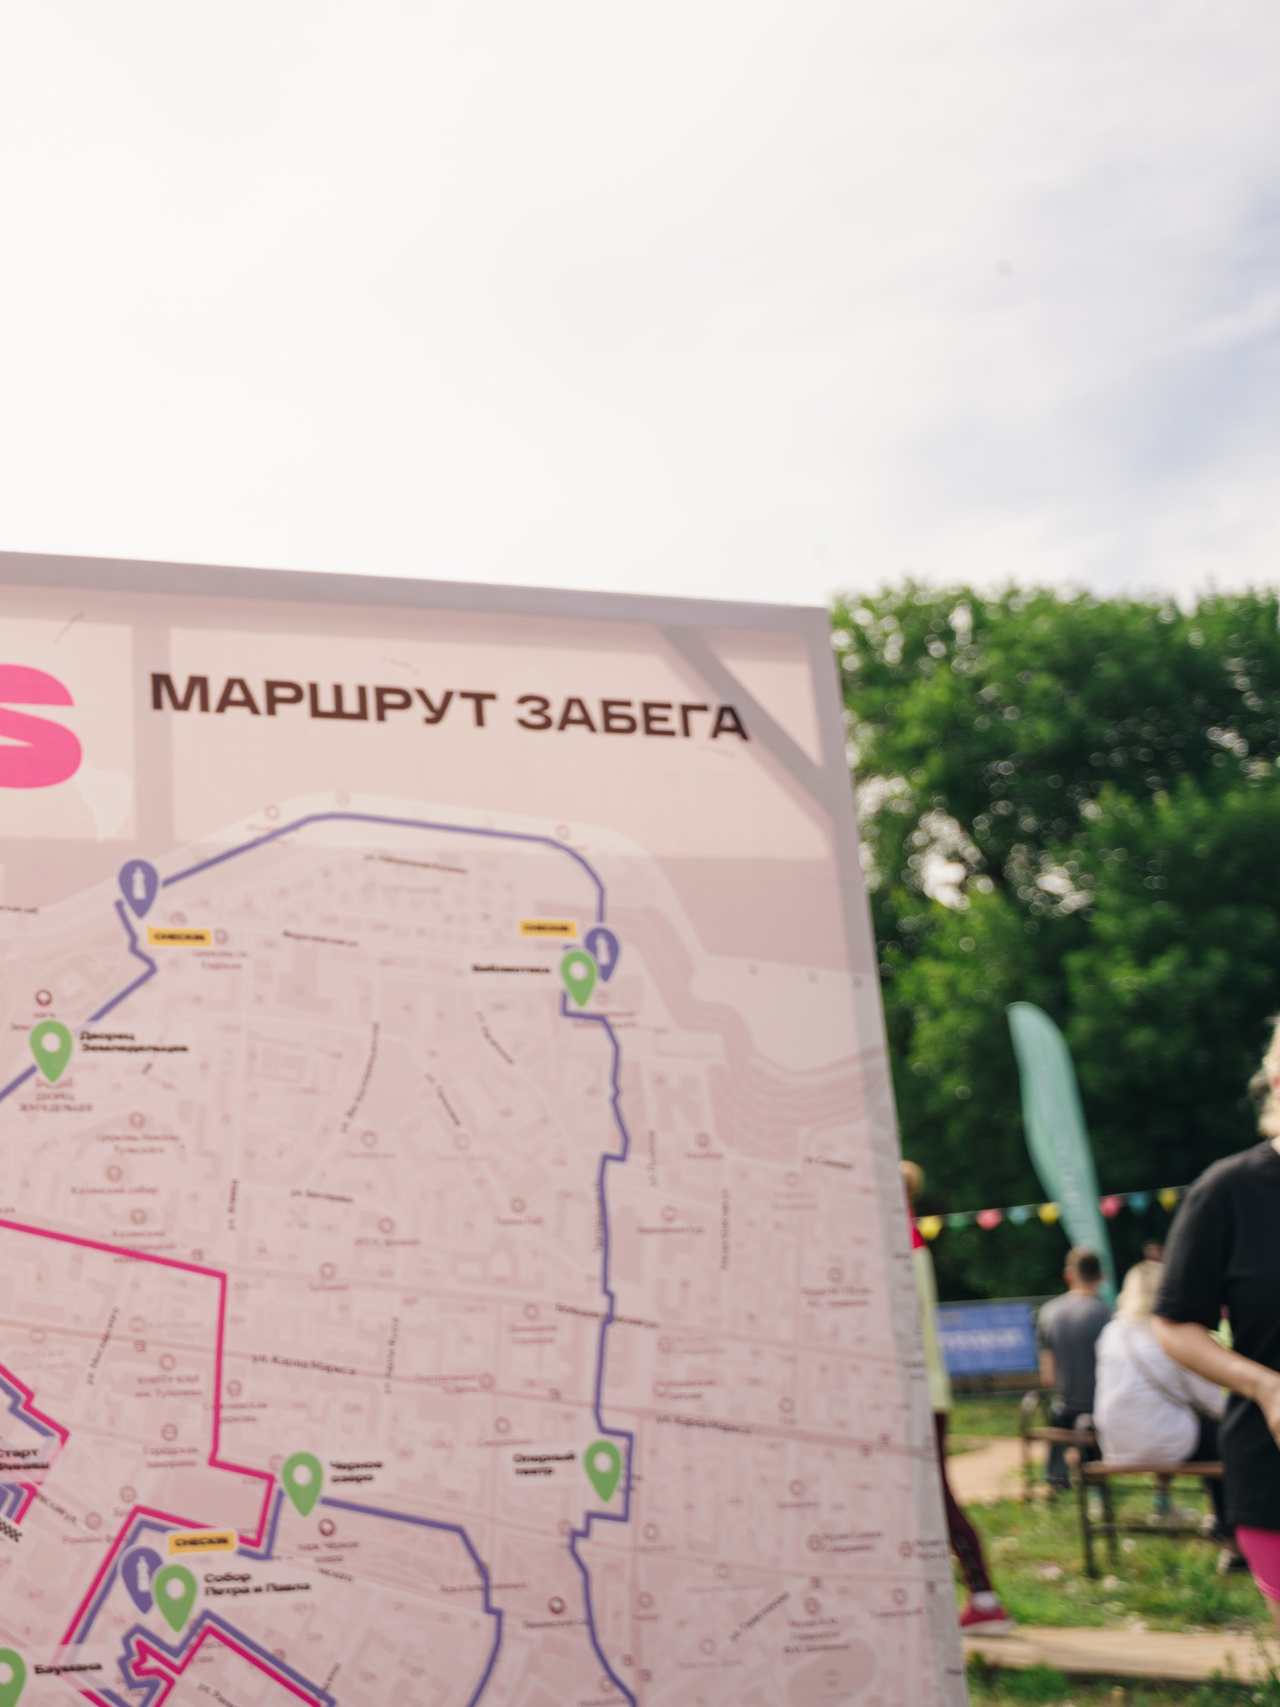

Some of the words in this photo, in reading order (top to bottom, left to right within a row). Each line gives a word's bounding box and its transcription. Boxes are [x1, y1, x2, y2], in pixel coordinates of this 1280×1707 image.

[150, 672, 496, 727] МАРШРУТ
[516, 695, 750, 742] ЗАБЕГА
[203, 1572, 253, 1584] Собор
[204, 1585, 251, 1597] Петра
[34, 1661, 103, 1676] Баумана
